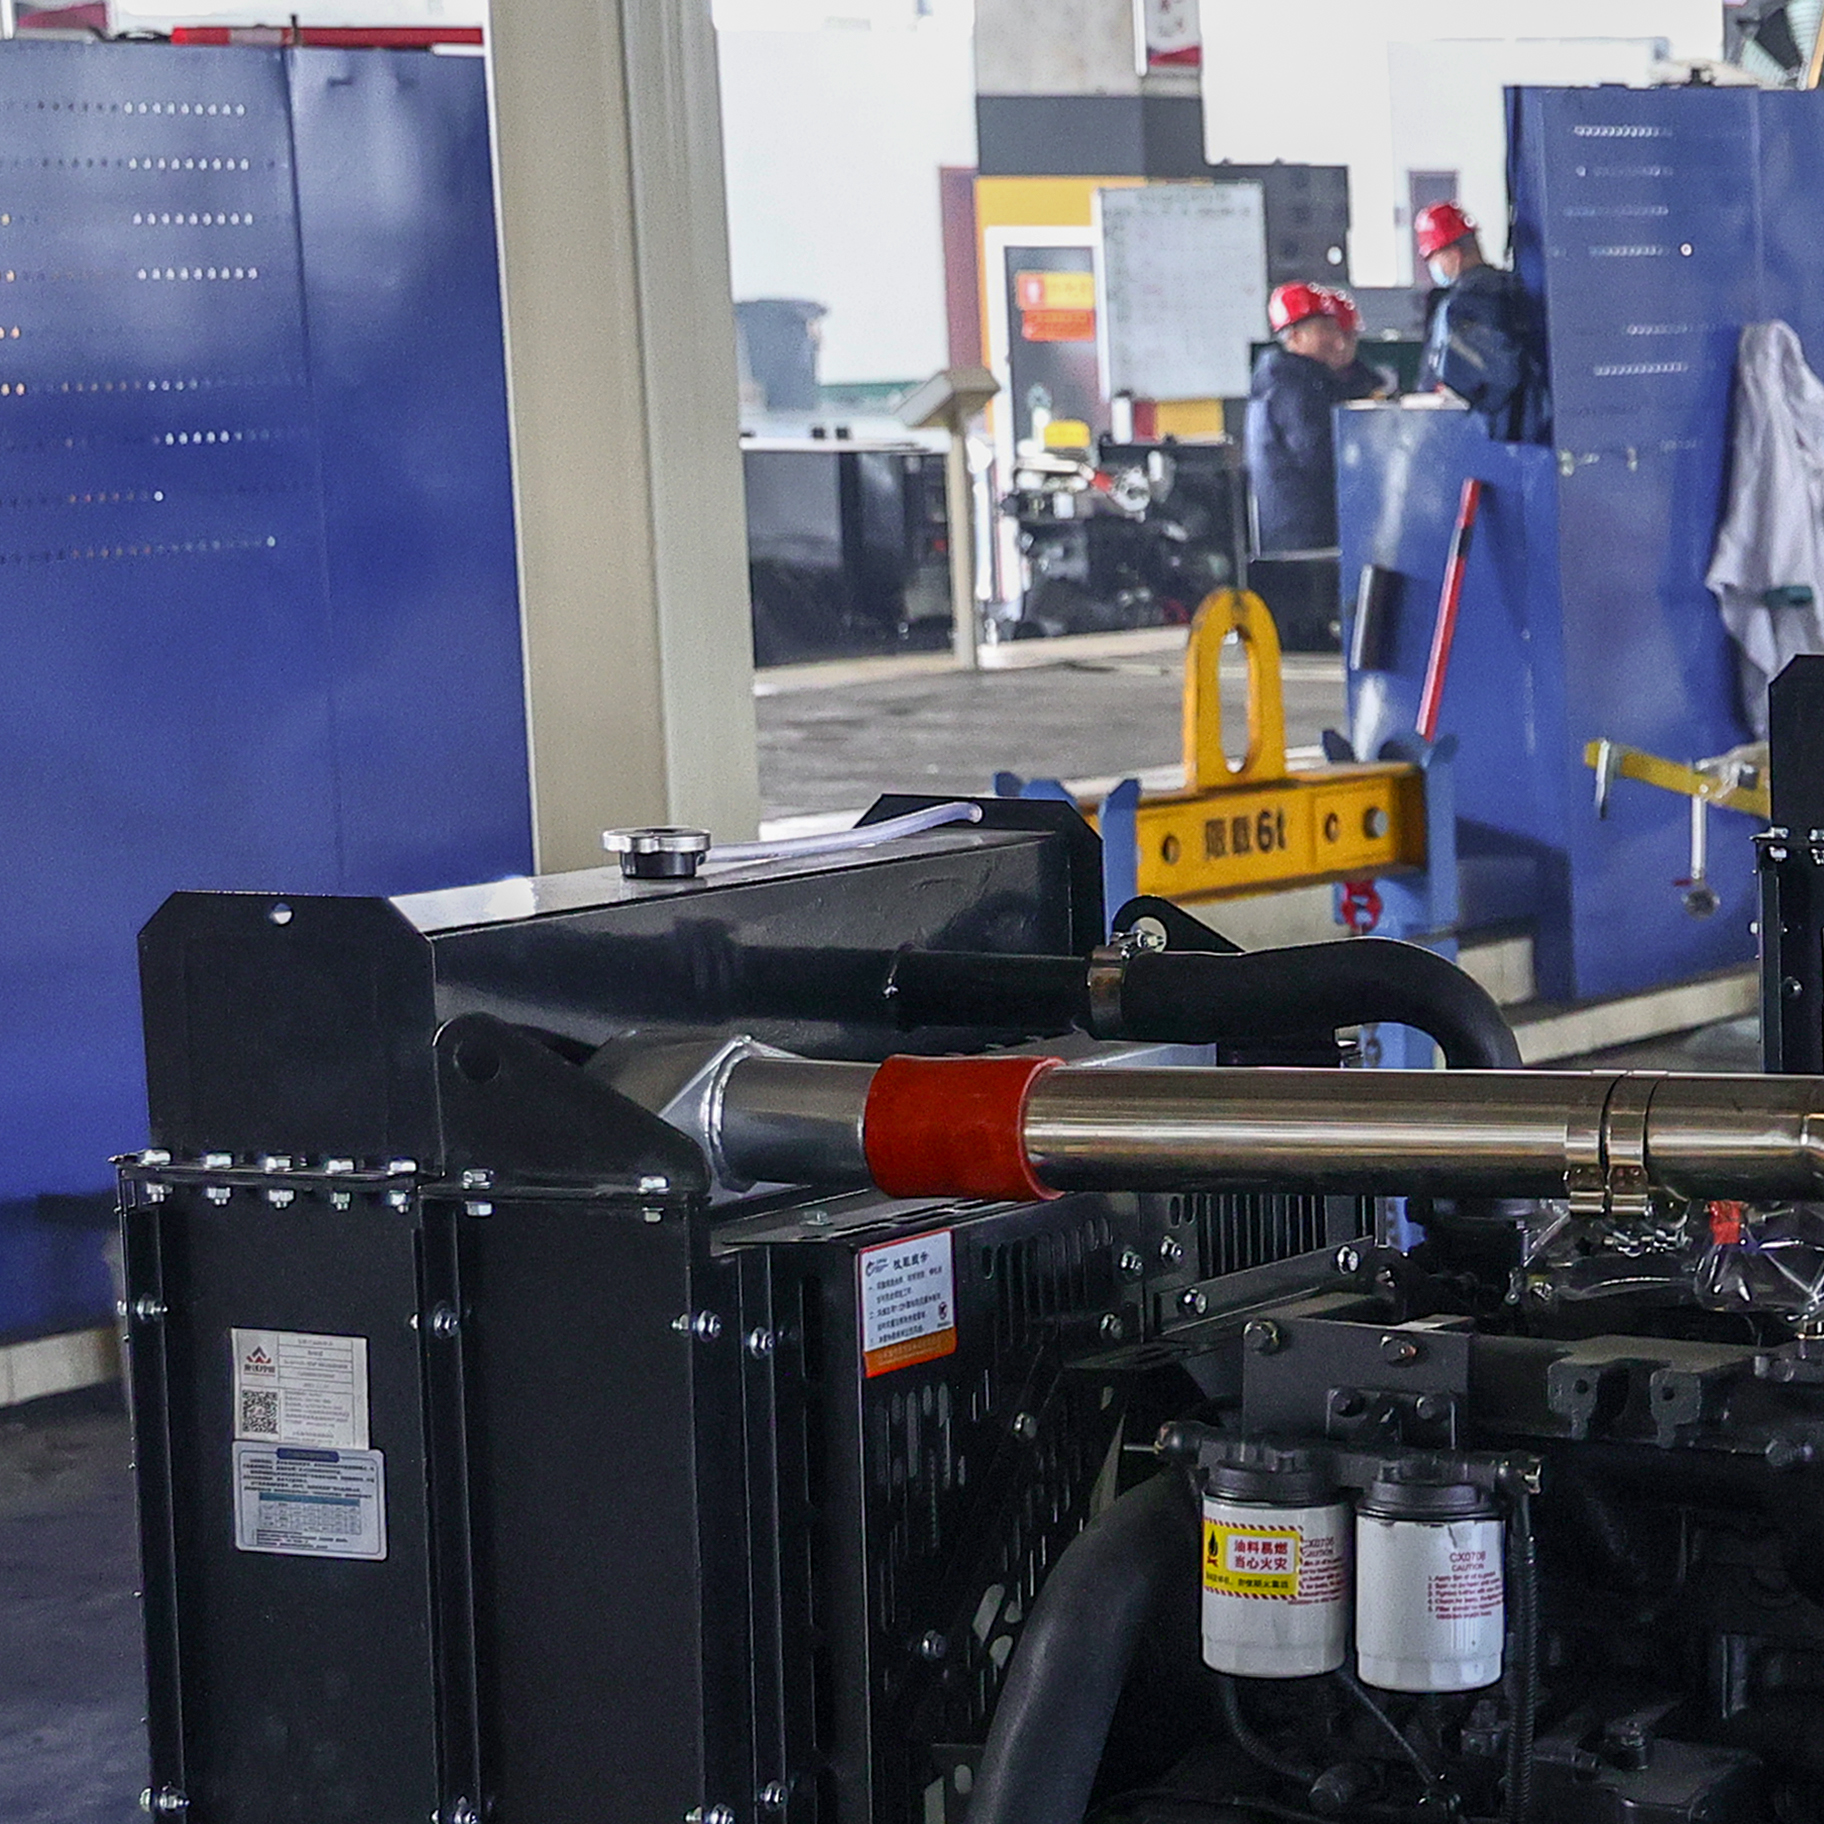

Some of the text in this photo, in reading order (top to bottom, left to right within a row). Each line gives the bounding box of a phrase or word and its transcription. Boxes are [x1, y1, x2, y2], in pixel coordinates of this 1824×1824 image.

[1234, 1539, 1289, 1555] 油料易燃
[1234, 1555, 1288, 1571] 当心火灾
[1451, 1563, 1485, 1572] CAUTION
